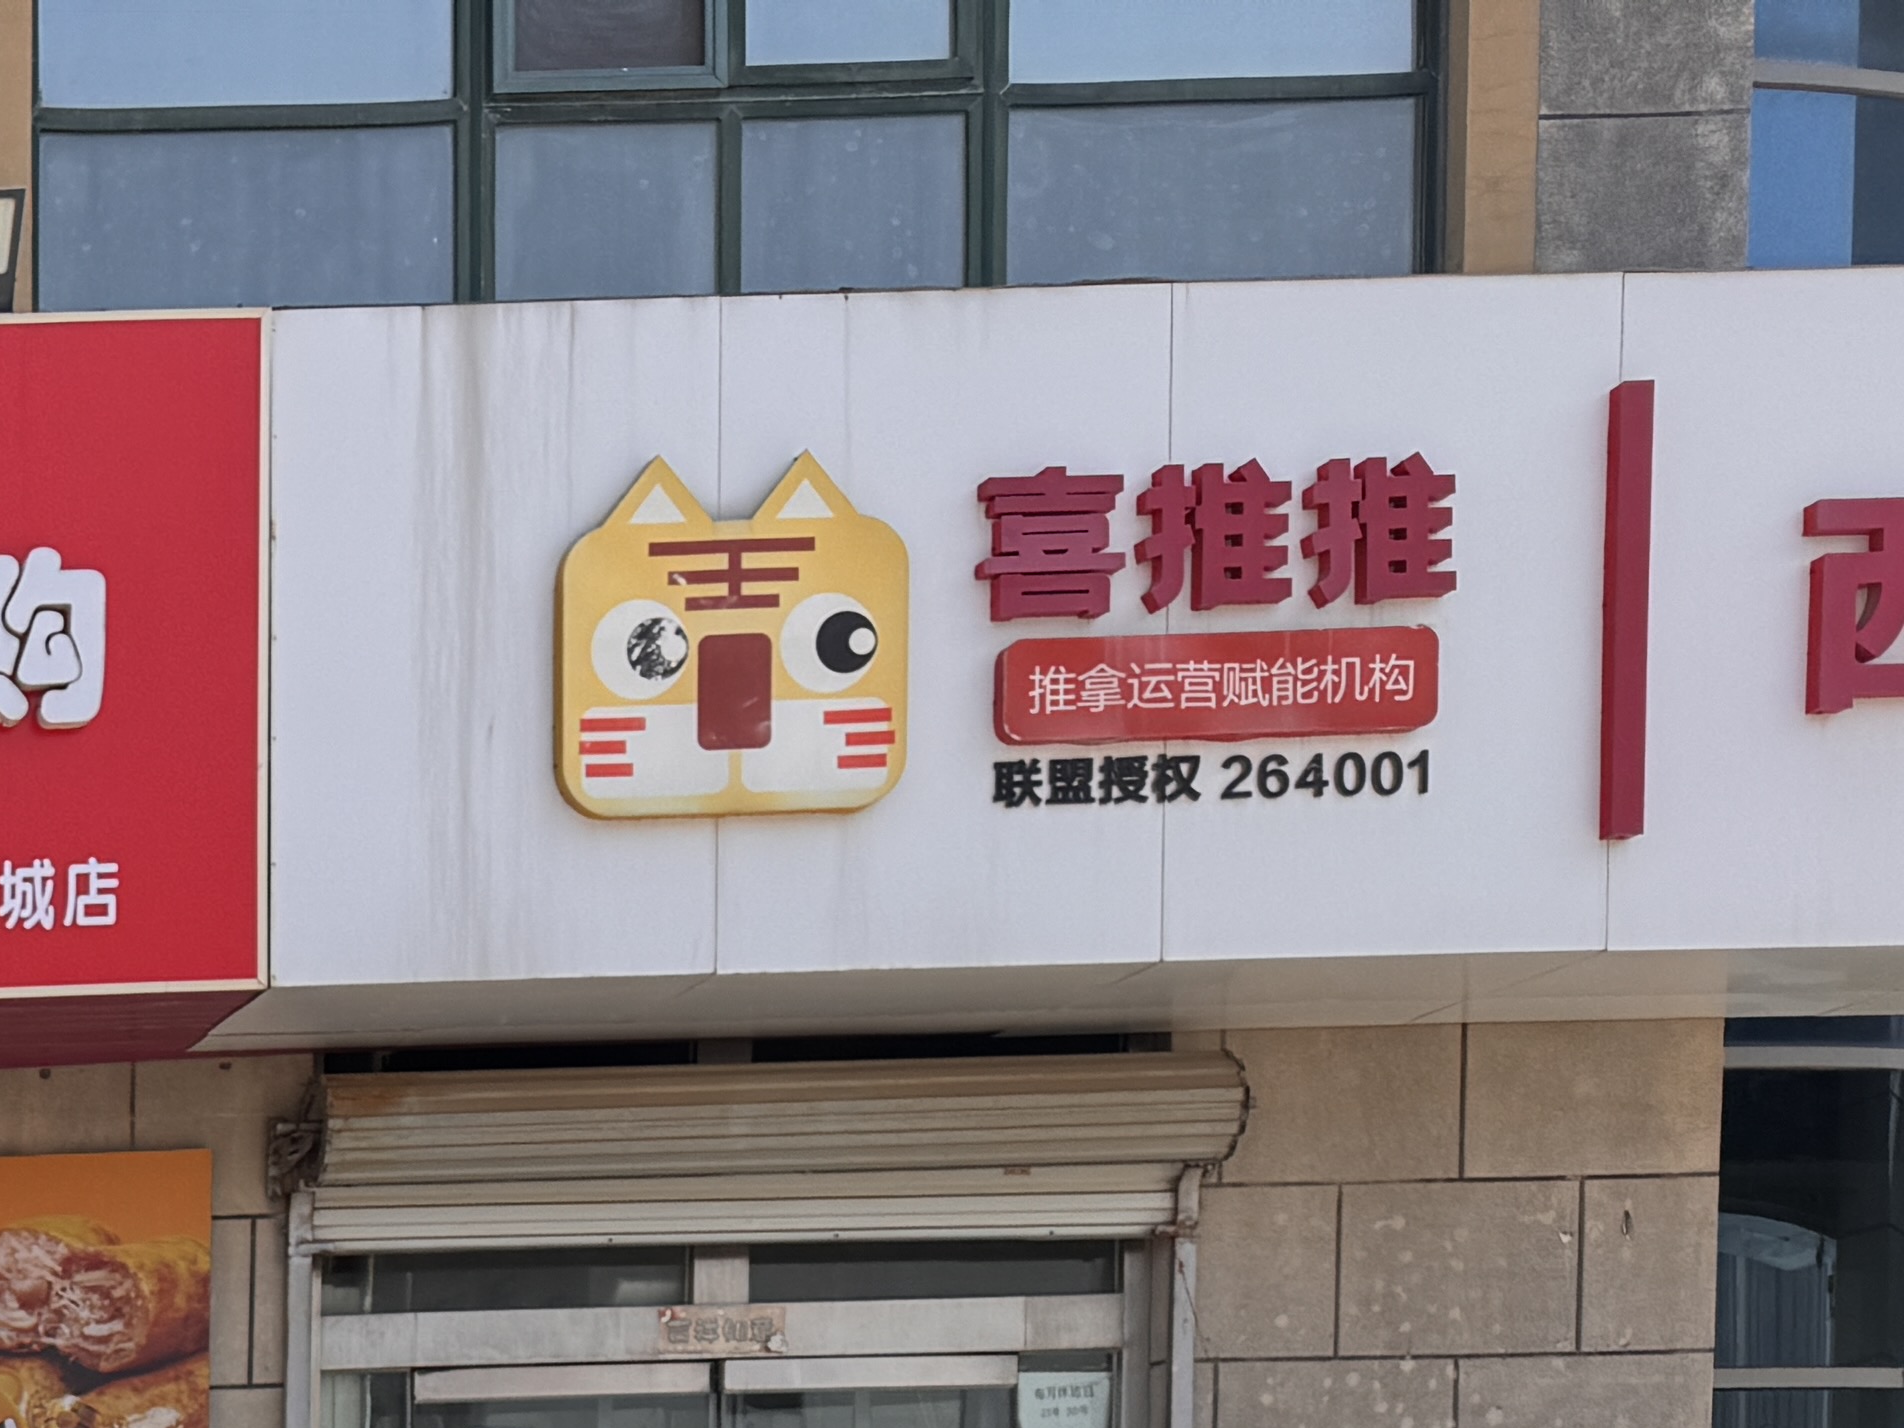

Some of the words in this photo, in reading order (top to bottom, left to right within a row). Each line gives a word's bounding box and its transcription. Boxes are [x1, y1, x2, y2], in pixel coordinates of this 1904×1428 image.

[975, 451, 1457, 623] 喜推推
[1028, 651, 1416, 716] 推拿运营赋能机构
[992, 752, 1201, 809] 联盟授权
[1220, 749, 1432, 800] 264001
